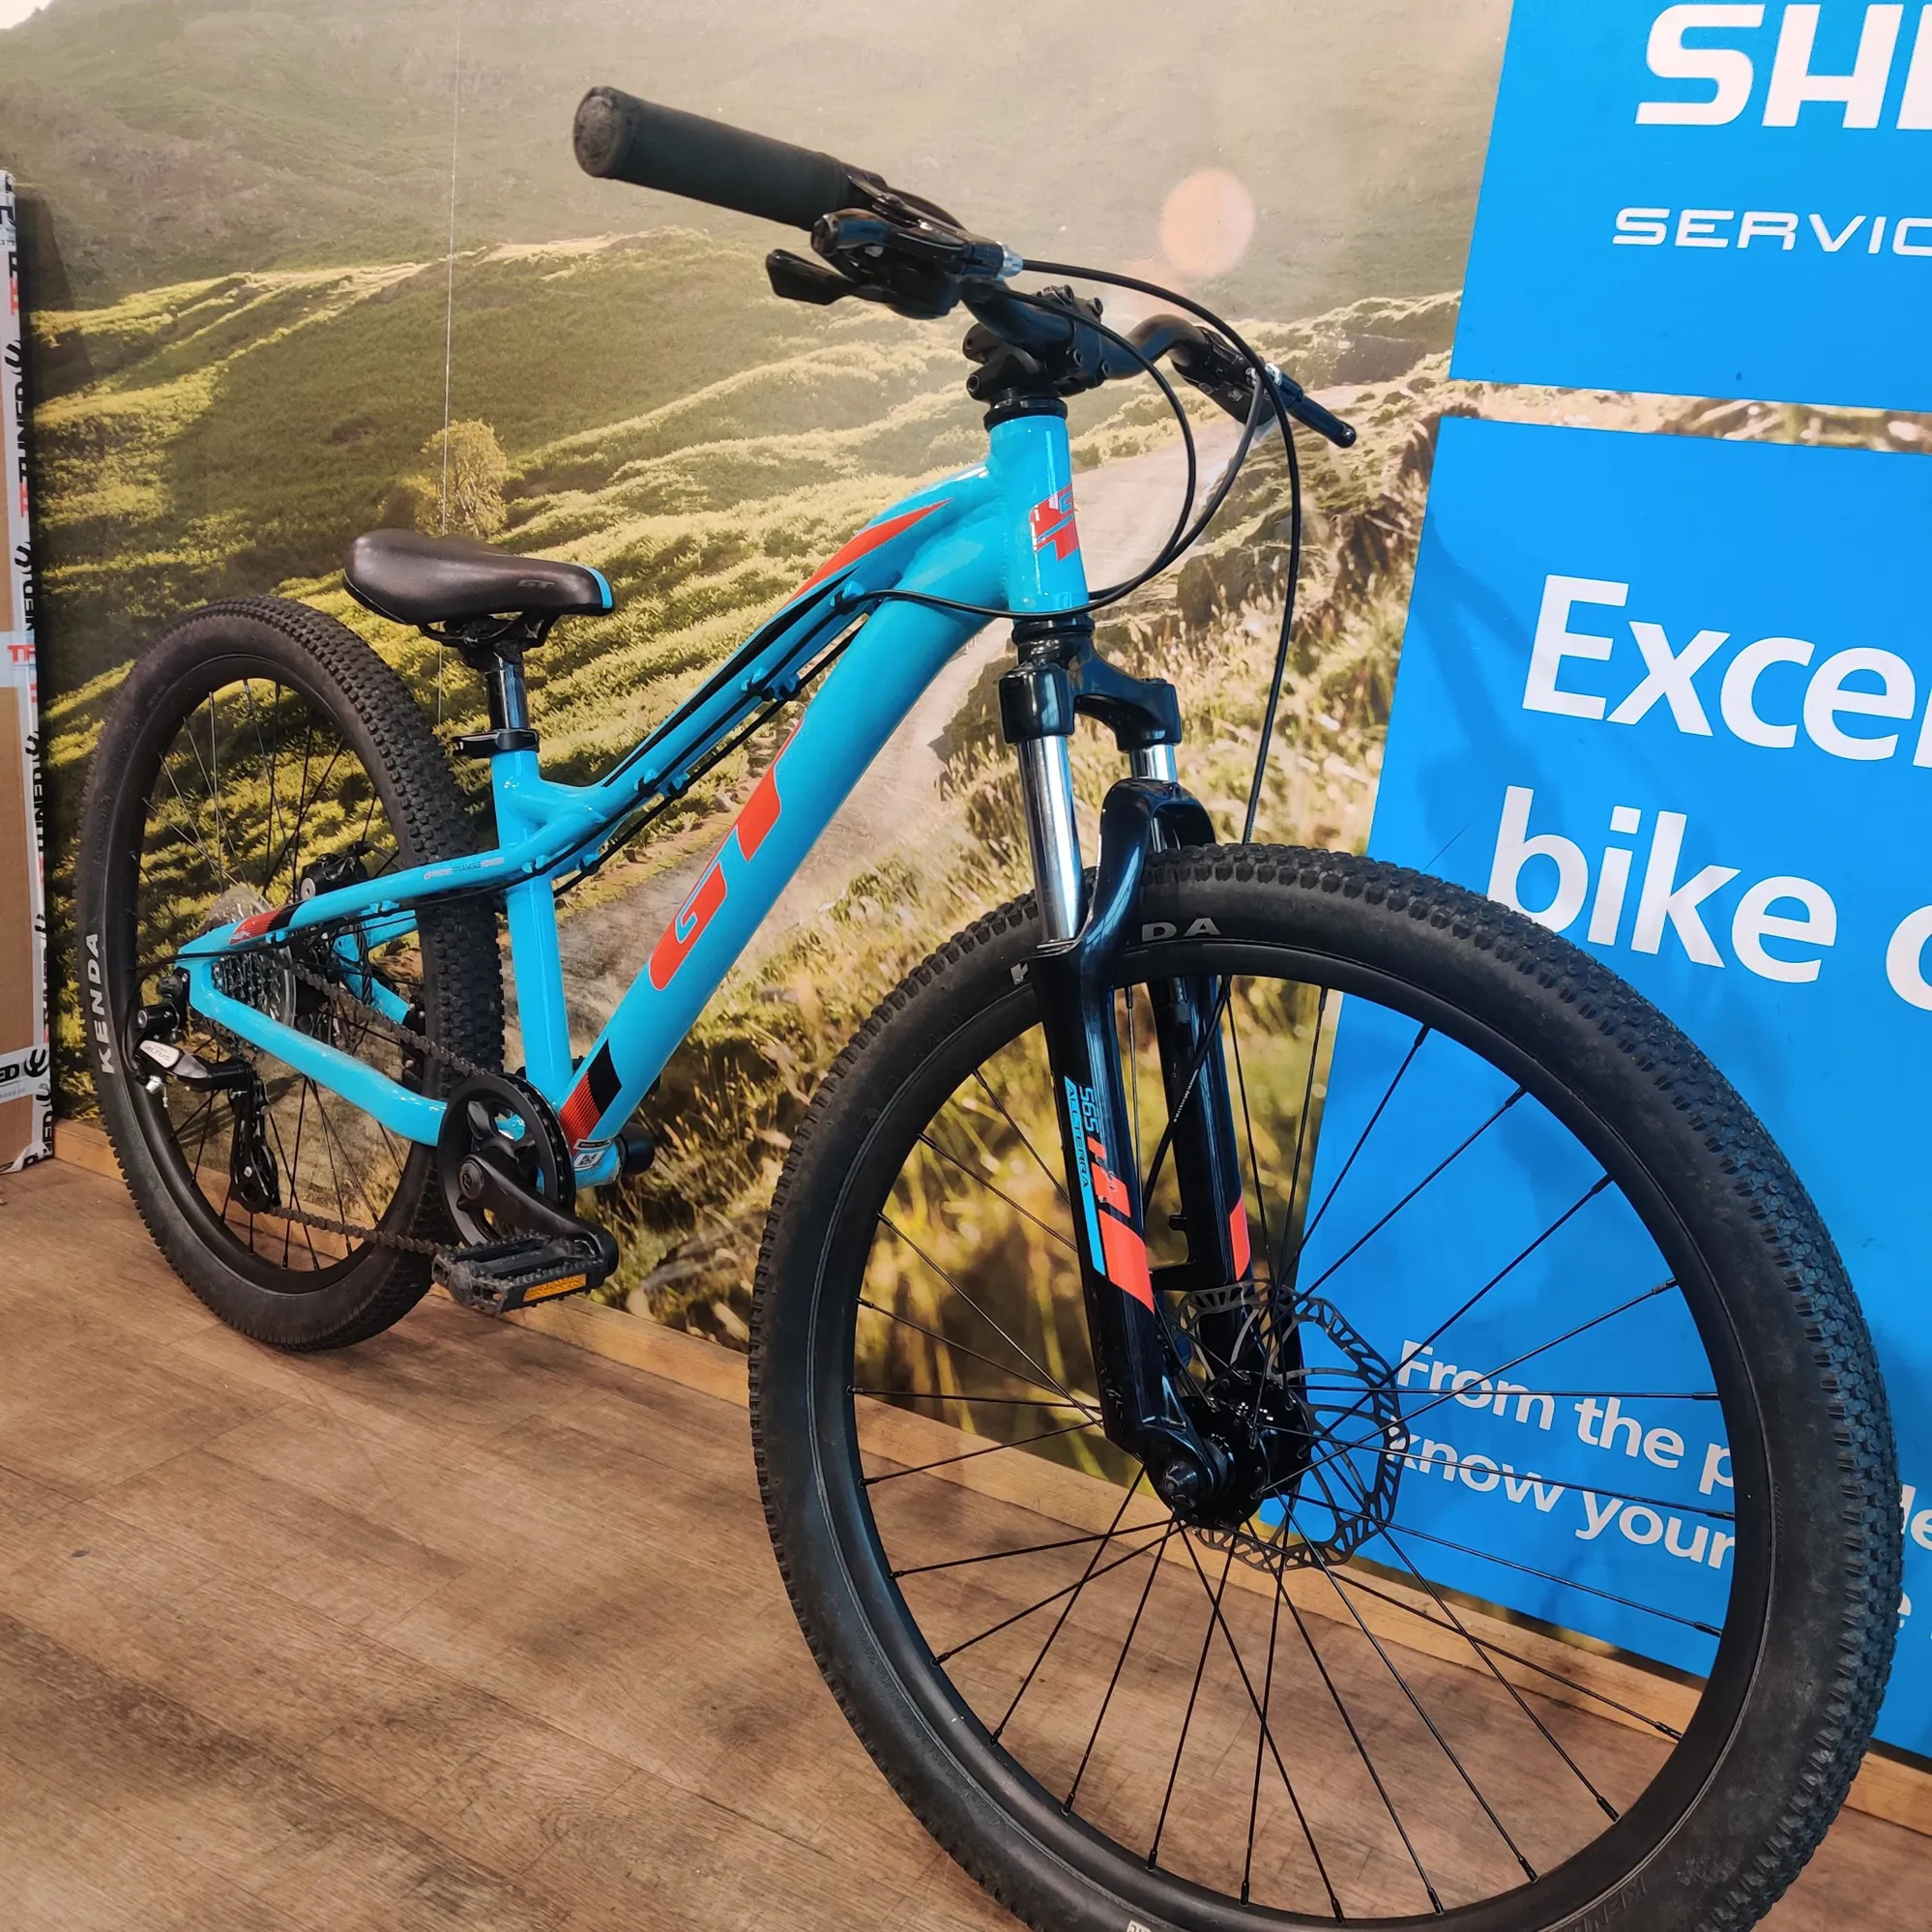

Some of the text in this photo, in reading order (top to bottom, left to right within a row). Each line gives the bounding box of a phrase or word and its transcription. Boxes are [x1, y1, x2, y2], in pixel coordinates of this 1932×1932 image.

[517, 579, 555, 589] GT
[1487, 785, 1837, 983] bike
[86, 933, 115, 1075] KENDA
[1397, 1339, 1555, 1431] From
[1574, 1396, 1684, 1469] the
[1574, 1490, 1735, 1569] your
